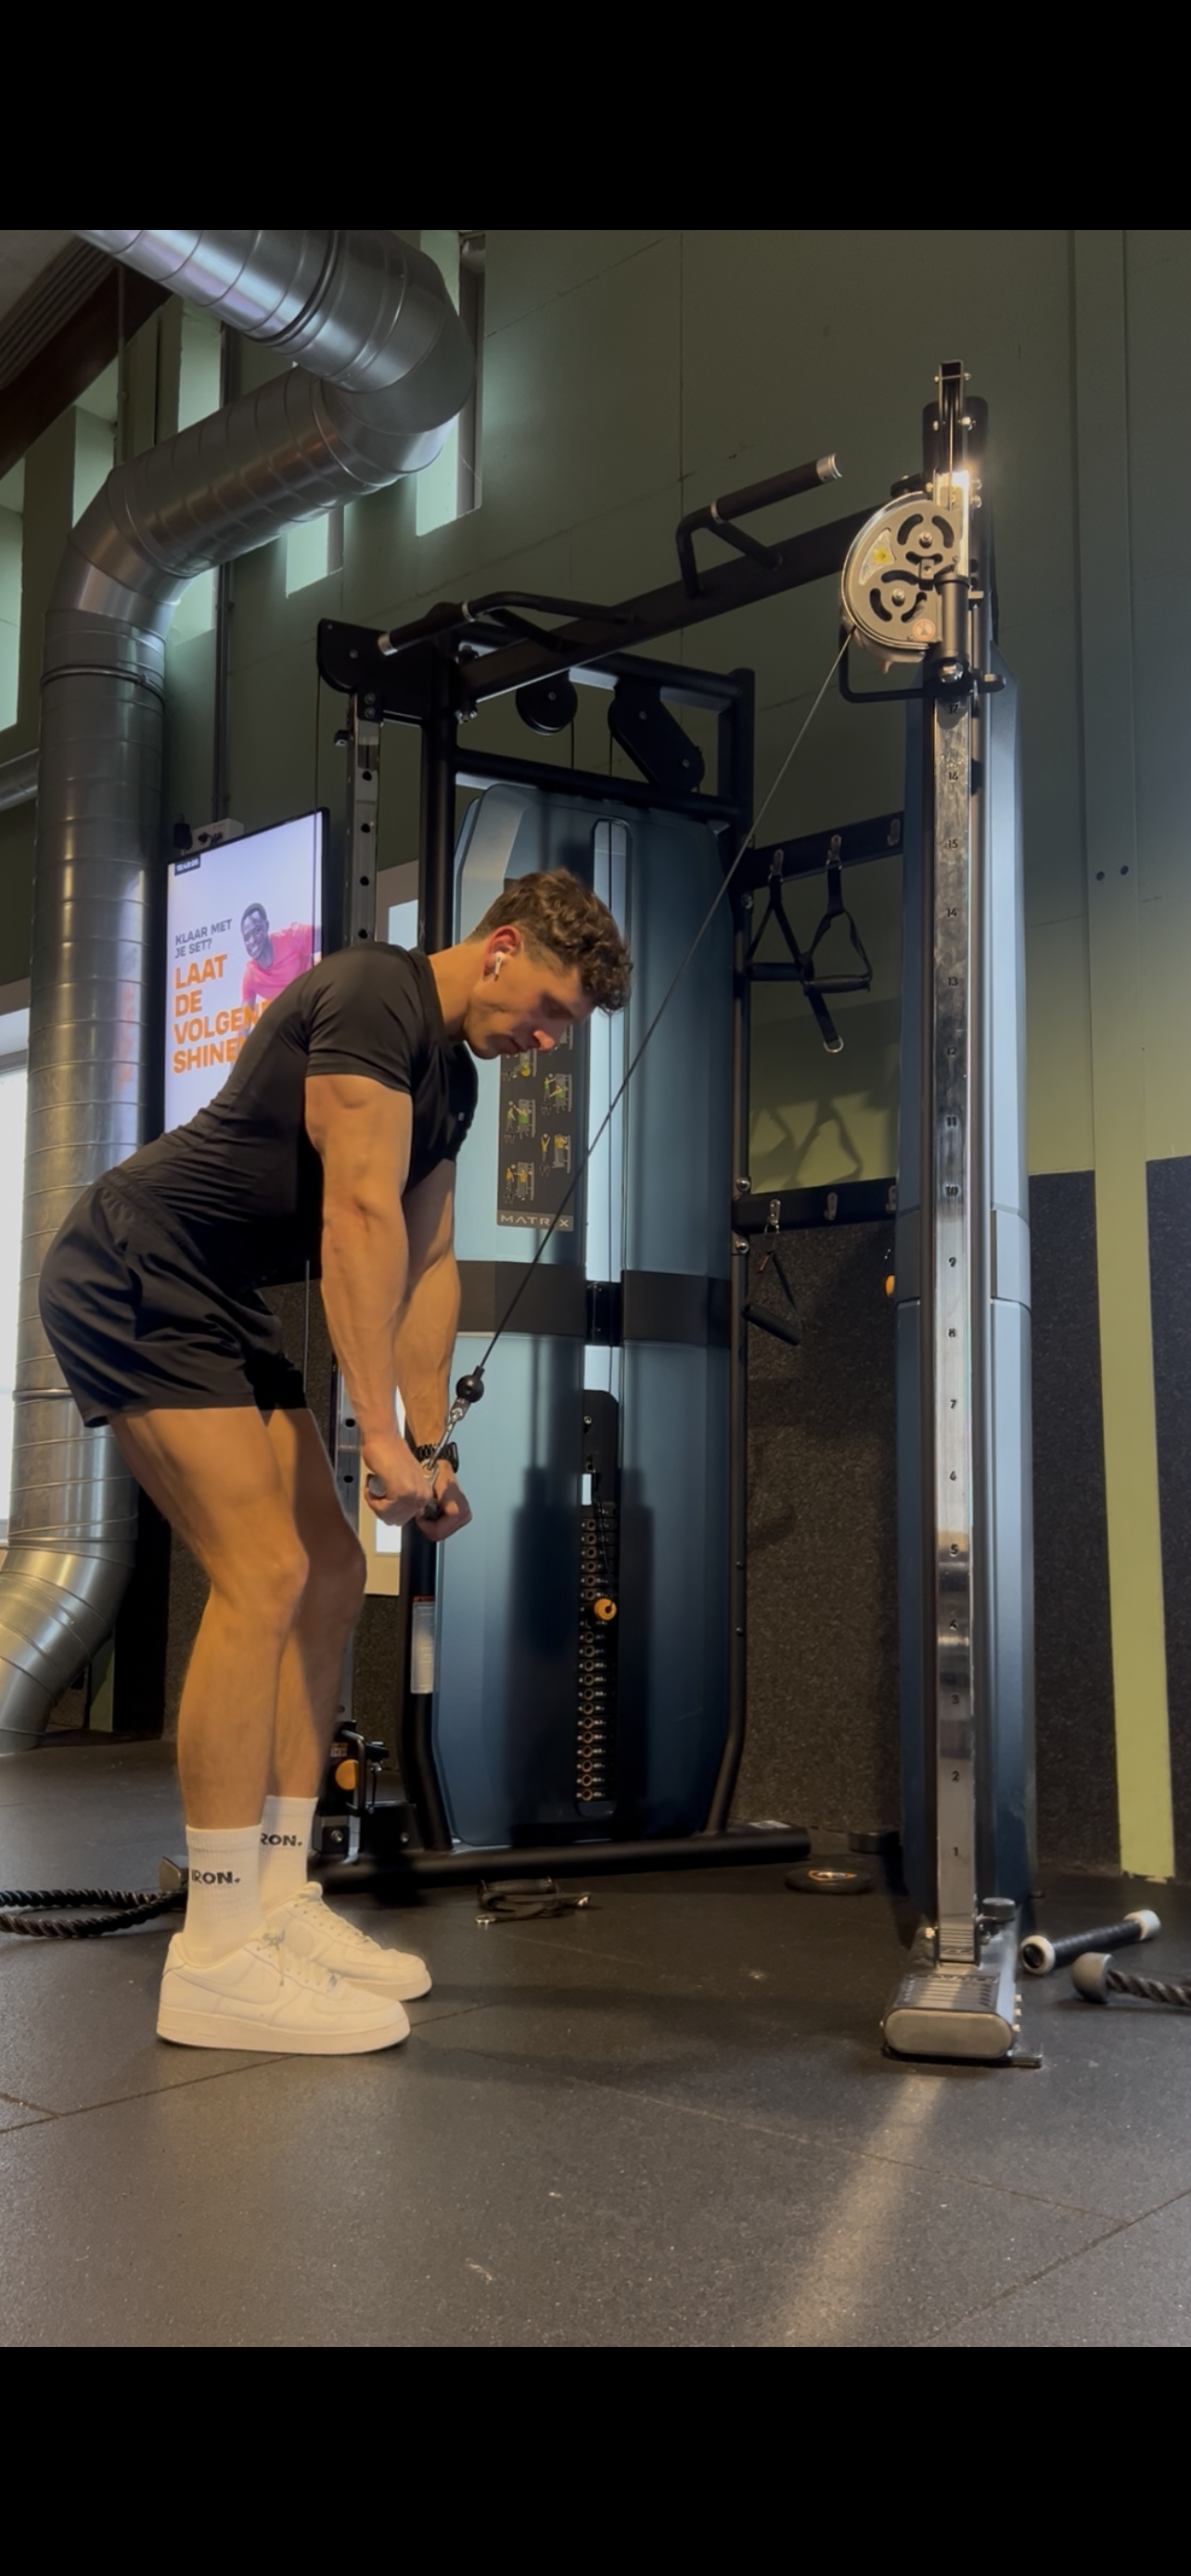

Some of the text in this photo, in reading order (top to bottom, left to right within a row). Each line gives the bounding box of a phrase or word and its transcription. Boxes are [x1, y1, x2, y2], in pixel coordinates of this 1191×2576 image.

[948, 839, 958, 848] 15
[947, 908, 957, 917] 14
[175, 919, 233, 946] KLAAR MET
[174, 938, 212, 959] JE SET?
[174, 953, 227, 989] LAAT
[948, 976, 958, 987] 13
[173, 988, 202, 1017] DE
[947, 1046, 957, 1055] 12
[946, 1116, 957, 1127] 11
[945, 1186, 958, 1197] 10
[501, 1214, 570, 1227] MATRX
[948, 1256, 957, 1267] 9
[948, 1327, 956, 1337] 8
[949, 1399, 957, 1409] 7
[949, 1471, 957, 1481] 6
[951, 1543, 959, 1554] 5
[951, 1694, 960, 1704] 3
[951, 1770, 960, 1781] 2
[953, 1847, 959, 1856] 1
[191, 1868, 241, 1884] IRON.
